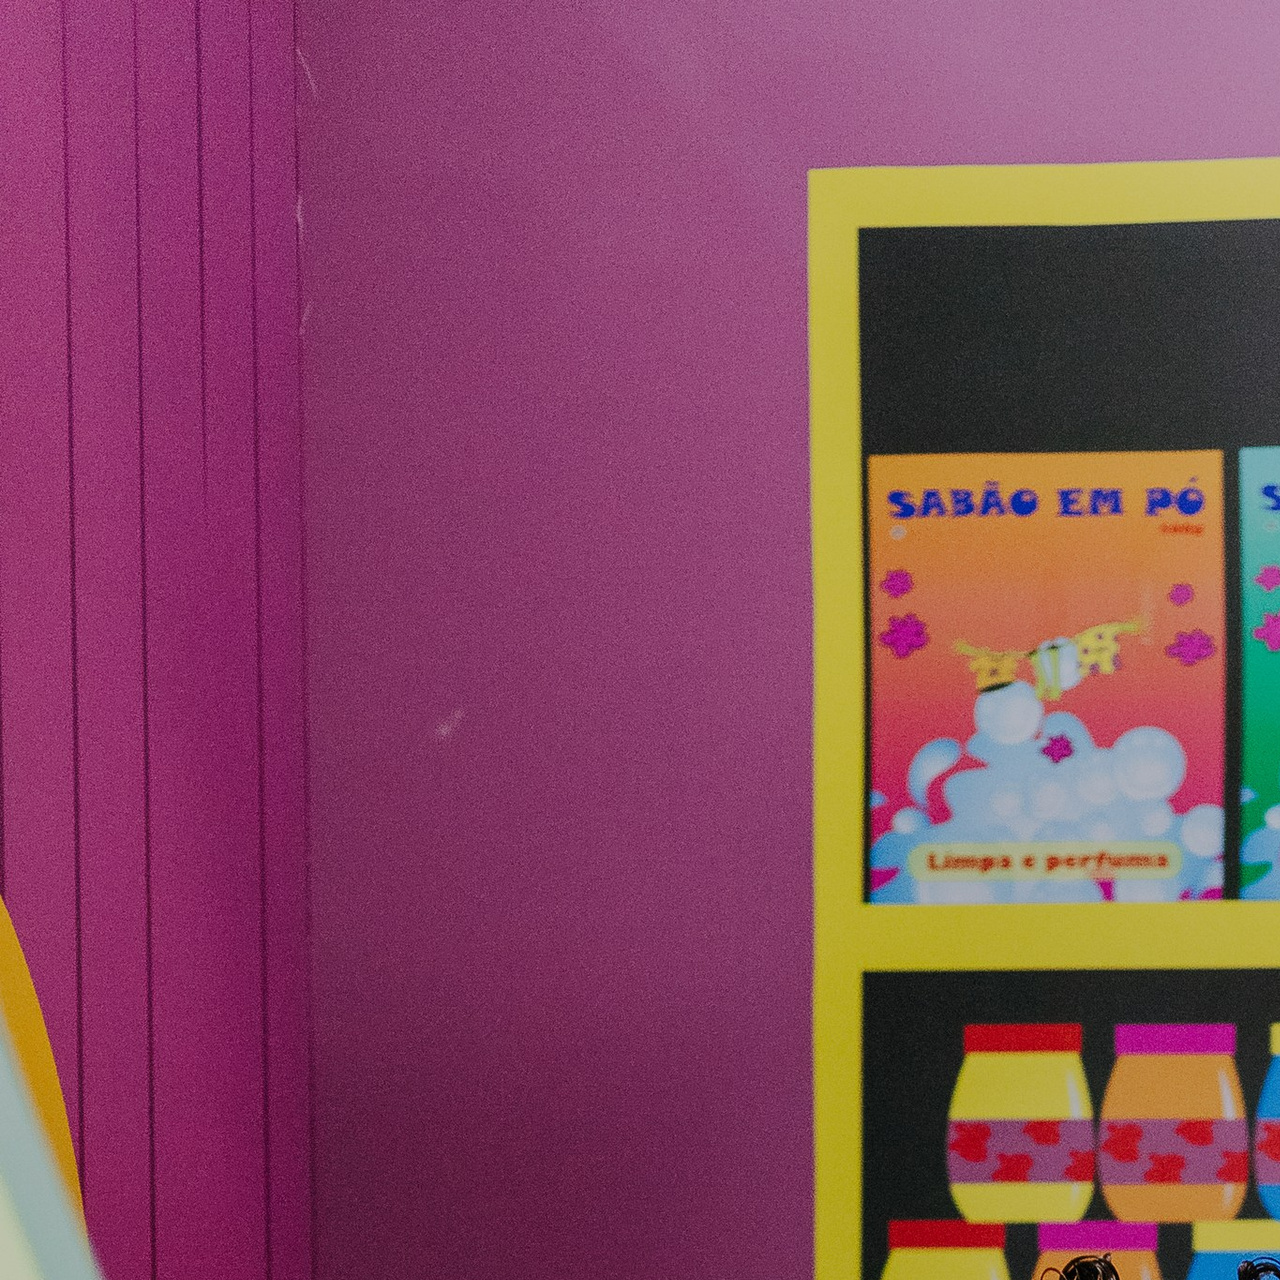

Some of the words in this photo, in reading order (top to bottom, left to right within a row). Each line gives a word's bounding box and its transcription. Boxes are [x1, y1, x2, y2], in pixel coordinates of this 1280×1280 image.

[887, 480, 1039, 520] SABÃO
[1057, 487, 1124, 518] EM
[1145, 476, 1205, 517] PÓ
[927, 852, 1011, 875] Limpa
[1046, 850, 1169, 874] perfuma
